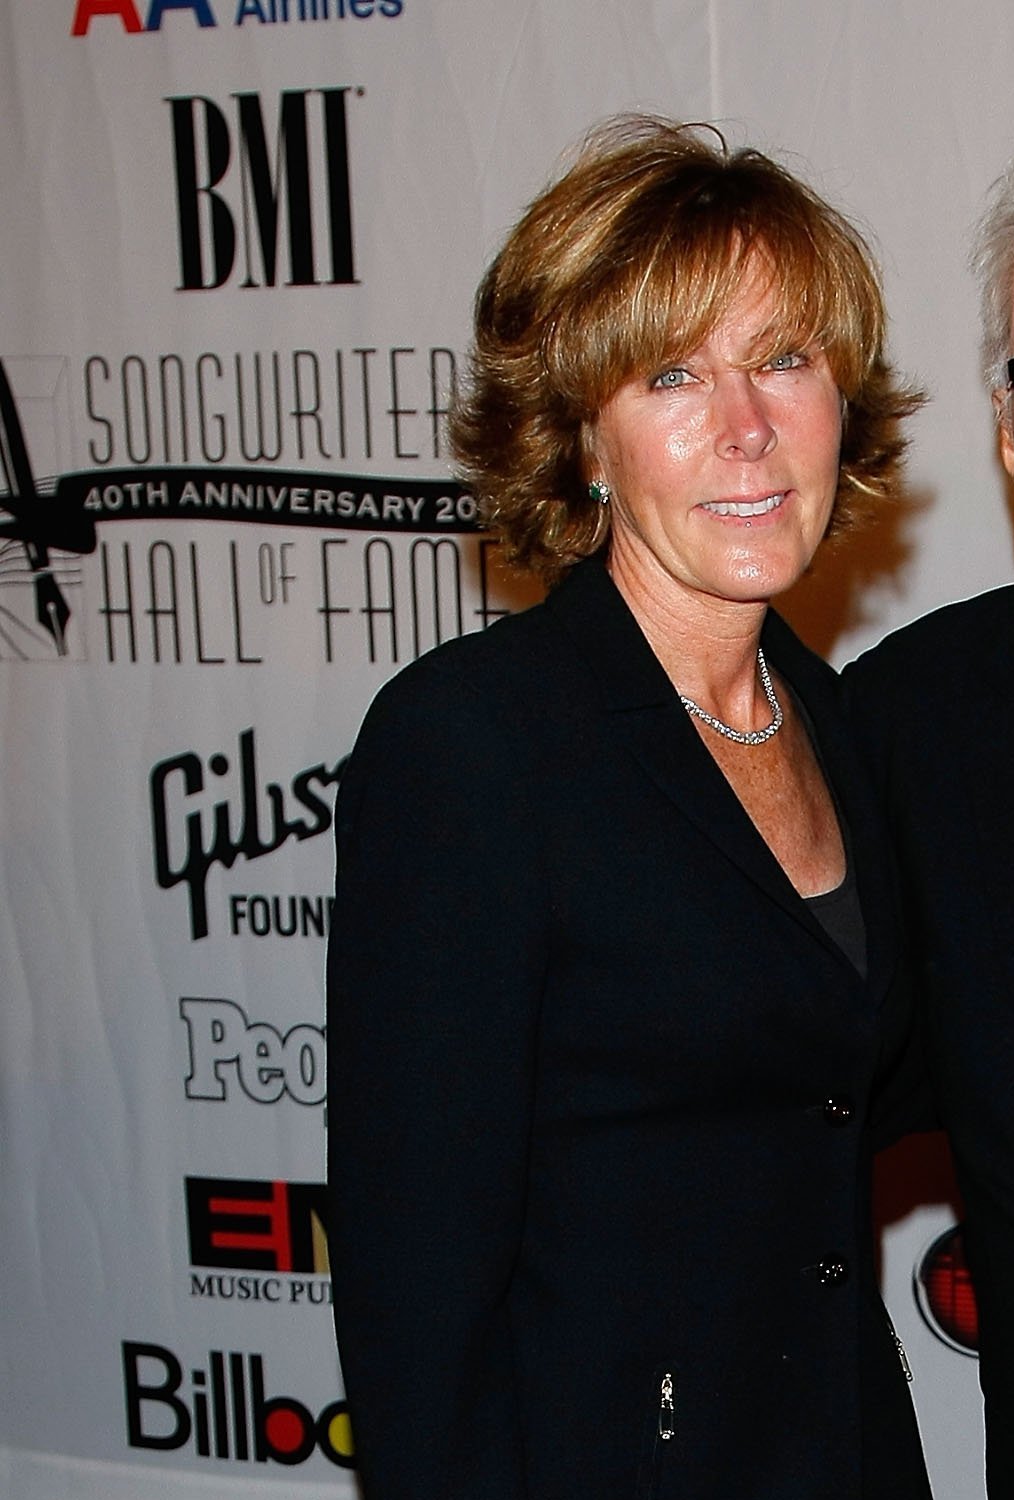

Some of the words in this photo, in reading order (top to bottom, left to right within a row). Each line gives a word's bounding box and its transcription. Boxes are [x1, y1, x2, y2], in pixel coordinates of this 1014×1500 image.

[163, 87, 361, 291] BMI
[83, 481, 169, 512] 40TH
[179, 481, 424, 521] ANNIVERSARY
[98, 540, 263, 664] HALL
[258, 541, 297, 605] OF
[149, 726, 352, 941] Gibs
[229, 893, 335, 937] FOUN
[178, 997, 327, 1126] Peo
[189, 1273, 281, 1302] MUSIC
[289, 1280, 334, 1305] PU
